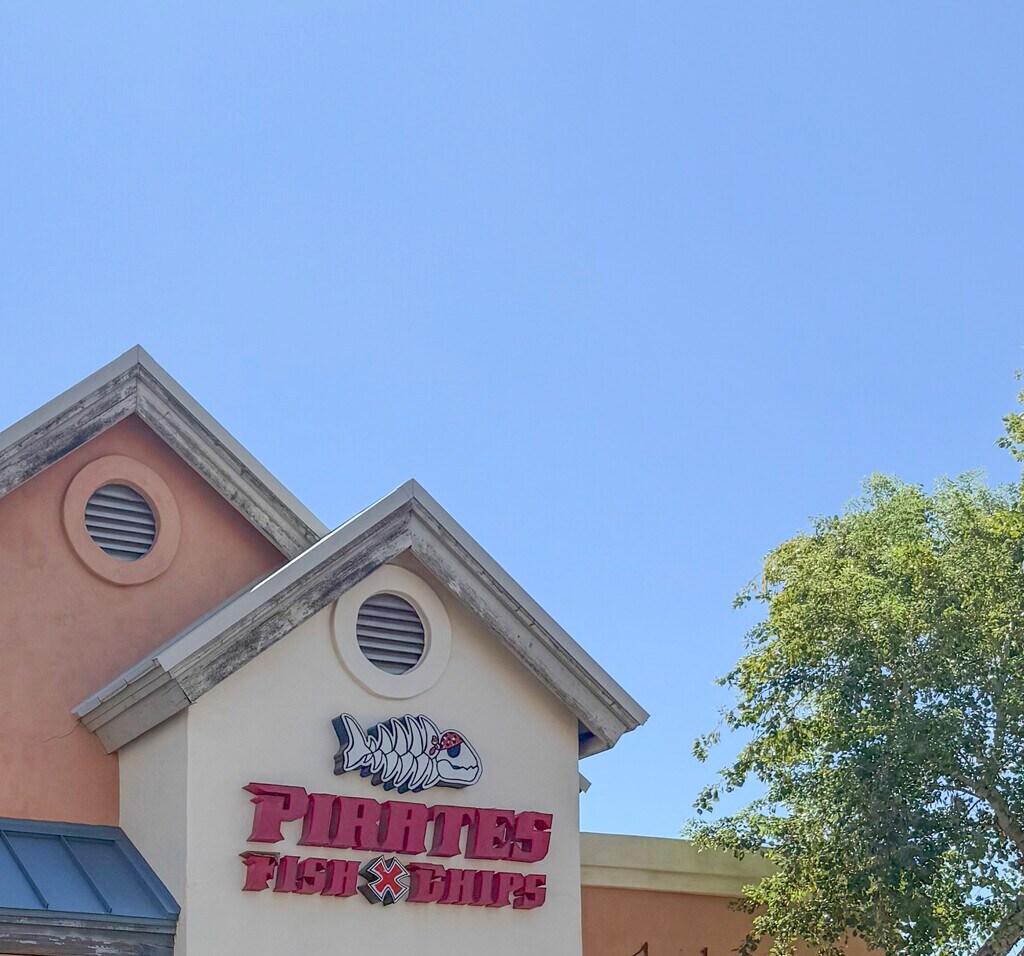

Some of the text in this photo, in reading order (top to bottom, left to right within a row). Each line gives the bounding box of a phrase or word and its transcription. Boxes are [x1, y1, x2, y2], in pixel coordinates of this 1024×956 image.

[242, 782, 554, 863] PIRATES
[239, 851, 547, 910] FISH CHIPS
